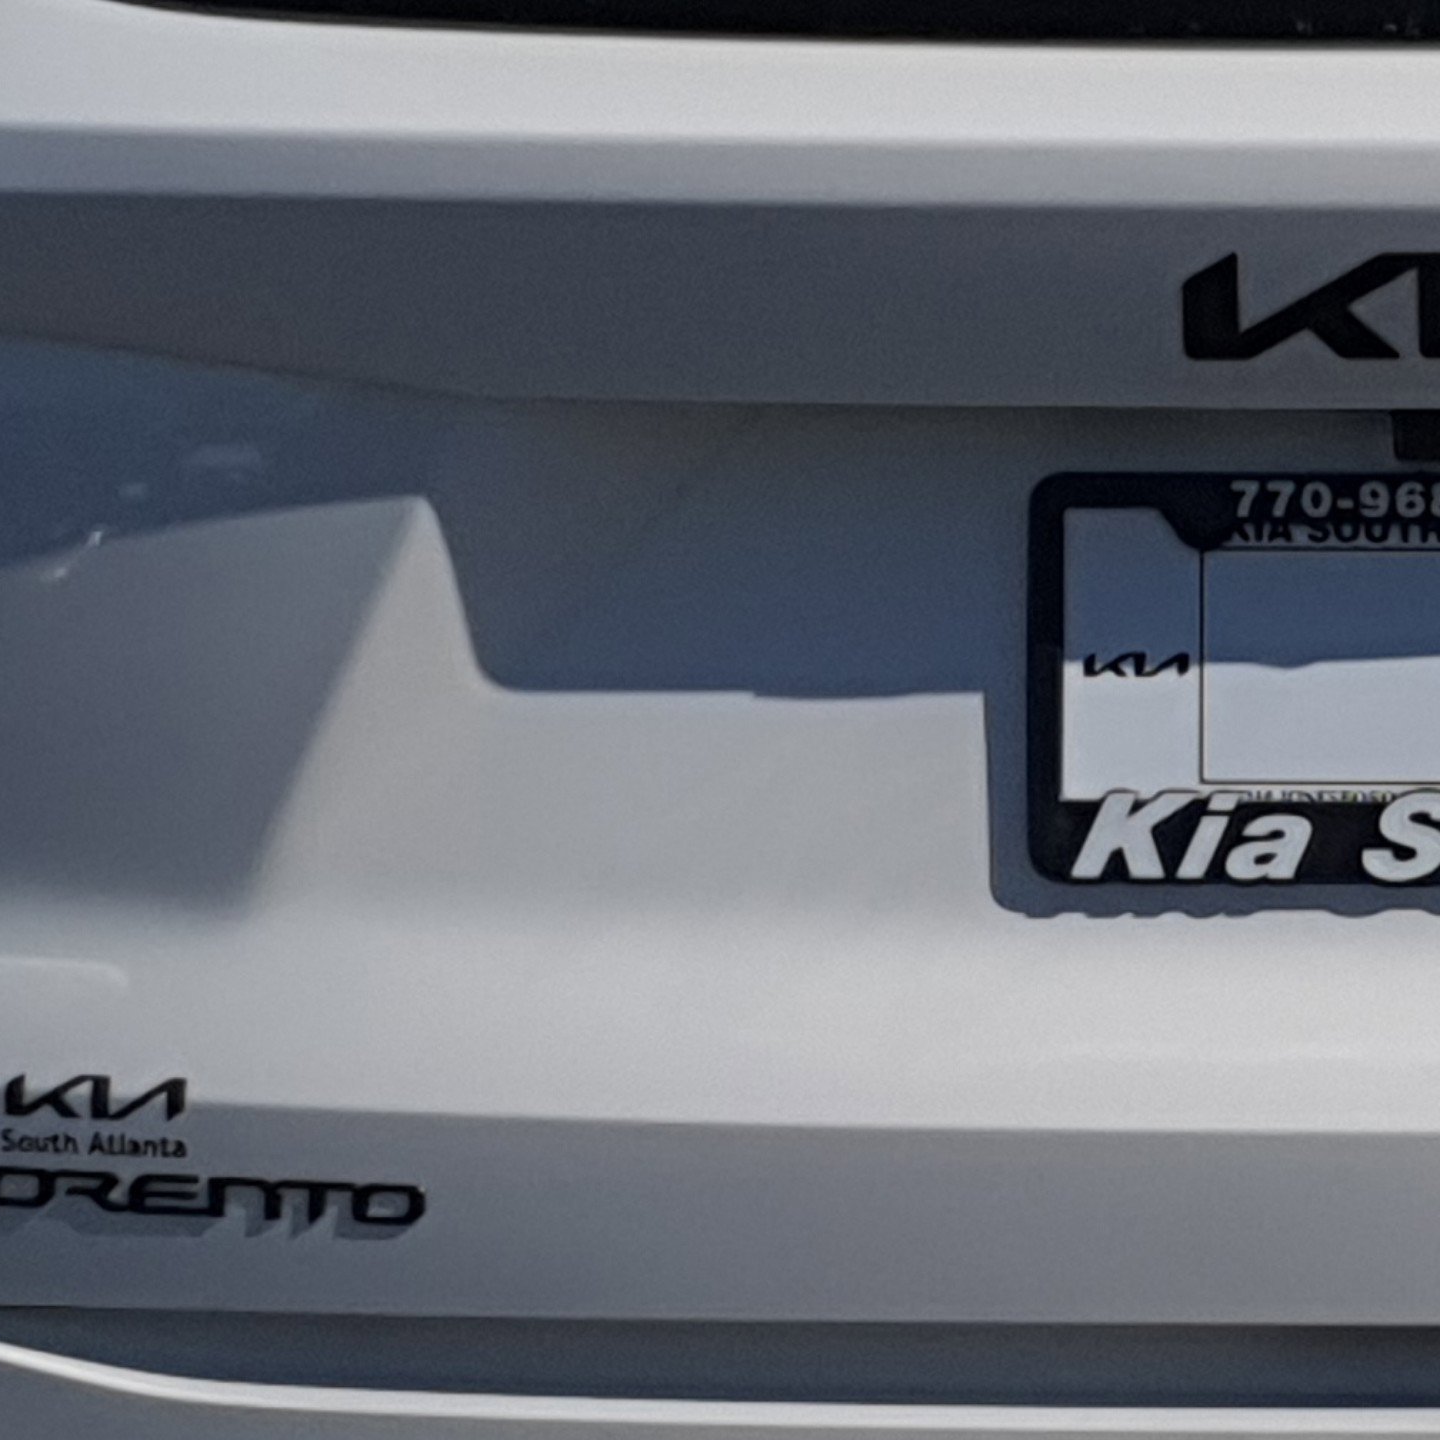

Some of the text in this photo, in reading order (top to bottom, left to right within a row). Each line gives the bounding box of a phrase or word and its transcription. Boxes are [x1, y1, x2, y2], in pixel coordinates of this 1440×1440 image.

[1083, 651, 1190, 677] KIA
[1070, 791, 1312, 882] Kia
[4, 1074, 187, 1121] KIA
[1, 1128, 188, 1158] South Atlanta
